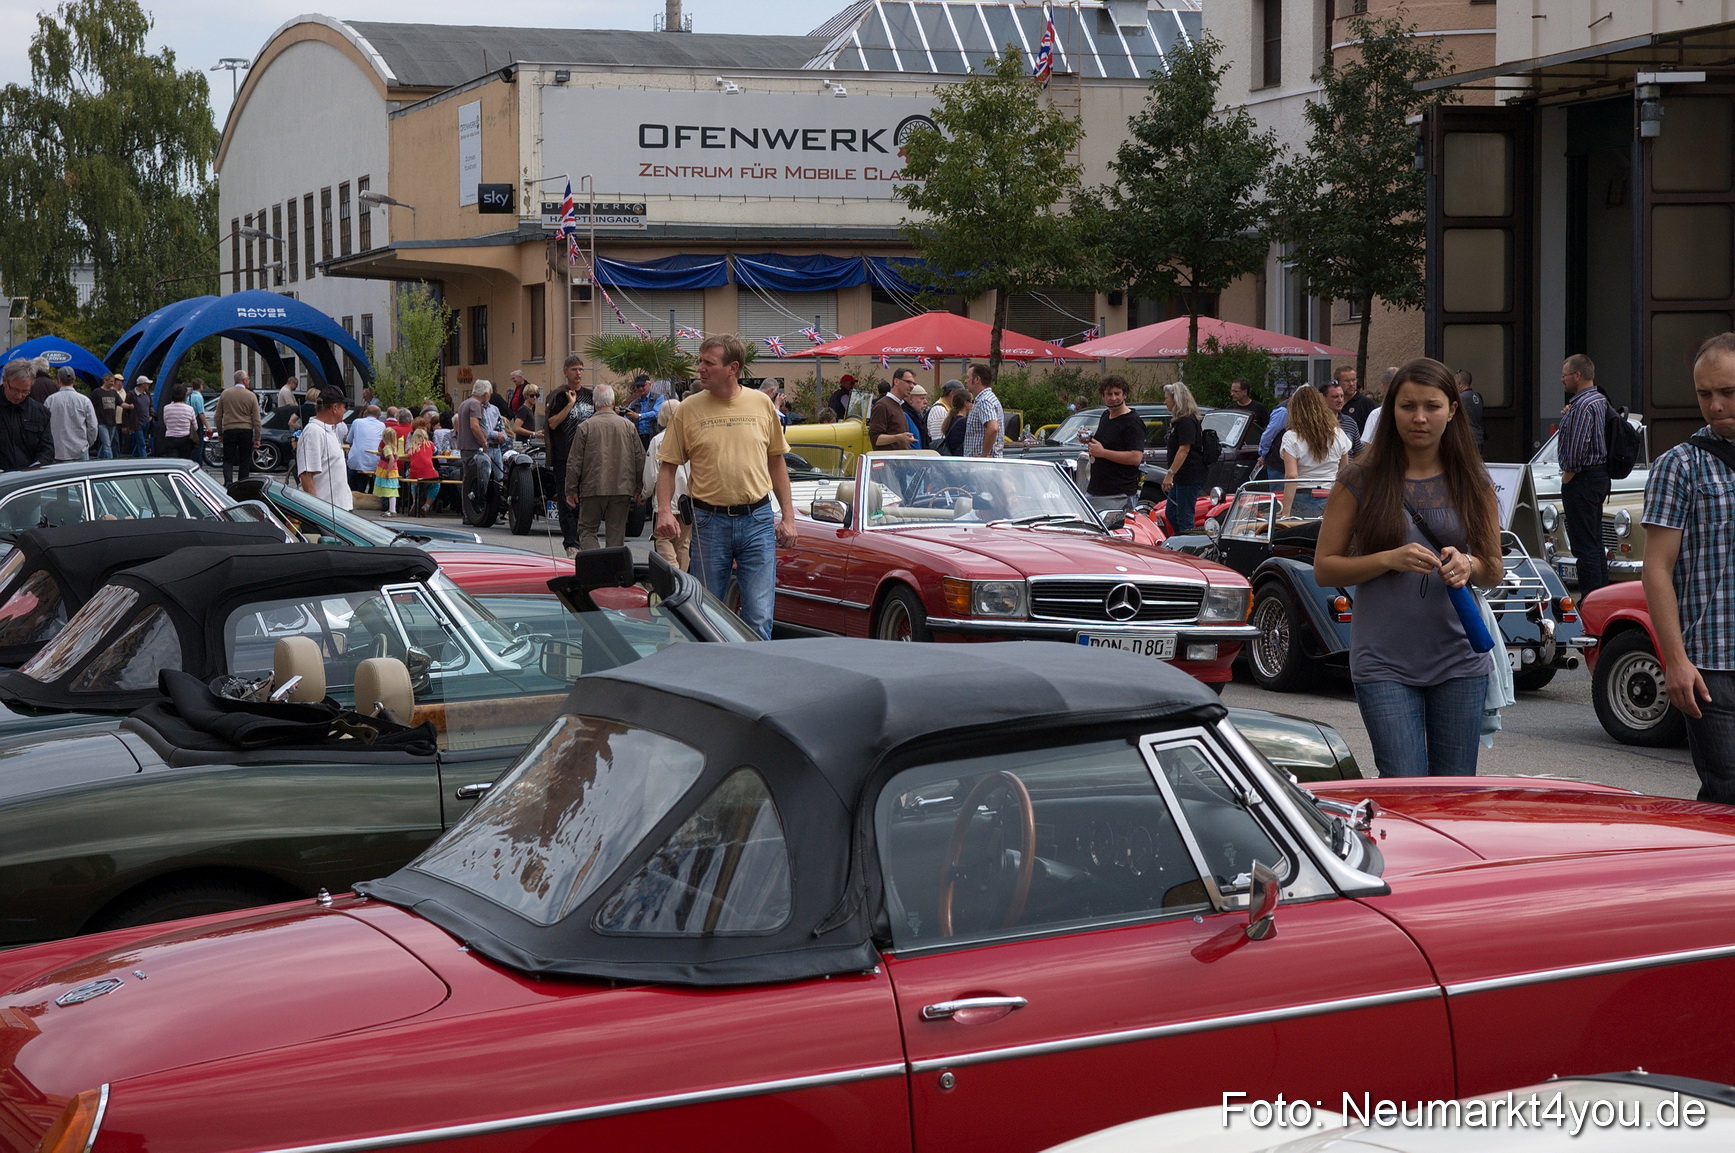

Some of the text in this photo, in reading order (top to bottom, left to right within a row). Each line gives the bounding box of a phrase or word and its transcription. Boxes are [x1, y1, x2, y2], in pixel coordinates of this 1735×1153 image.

[638, 123, 889, 154] OFENWERK
[638, 163, 733, 178] ZENTRUM
[740, 163, 777, 180] FÜR
[785, 166, 857, 181] MOBILE
[483, 190, 509, 207] sky
